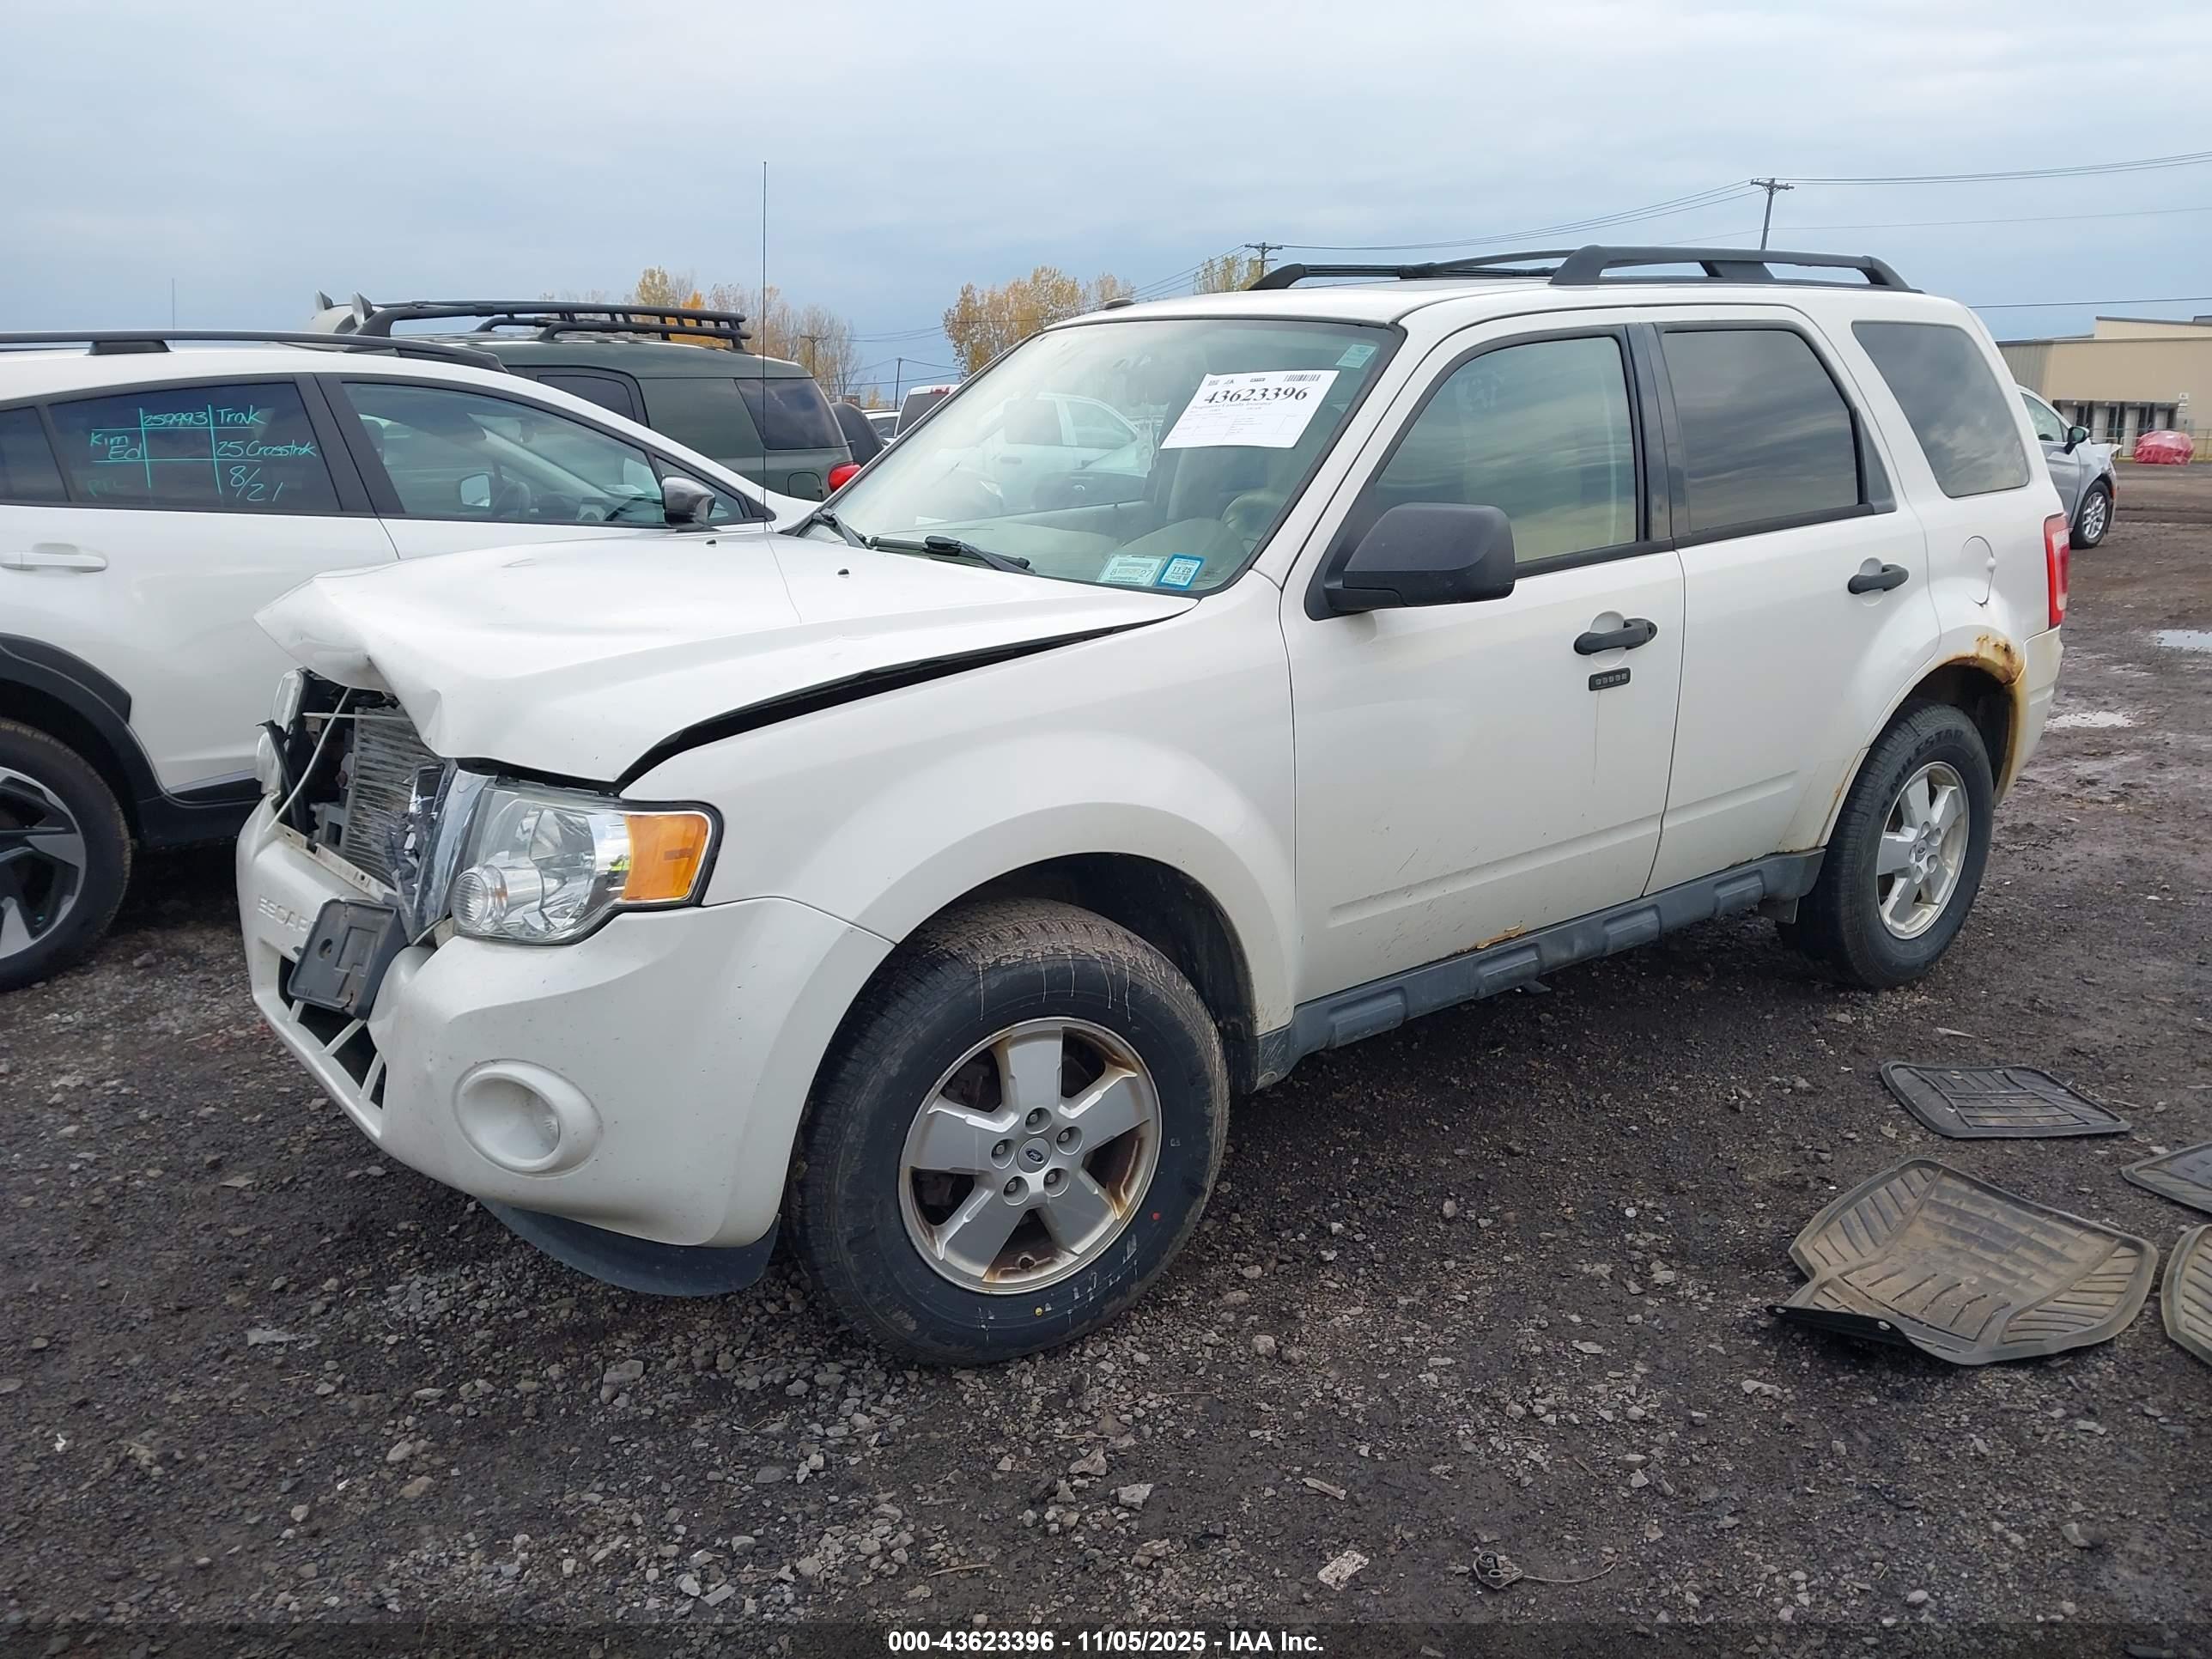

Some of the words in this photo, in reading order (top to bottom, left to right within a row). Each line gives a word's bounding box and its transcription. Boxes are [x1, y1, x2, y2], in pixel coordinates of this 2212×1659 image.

[1204, 386, 1311, 404] 43623396
[143, 411, 208, 426] 259993
[89, 432, 129, 447] Kim
[108, 443, 142, 460] Ed
[216, 441, 244, 457] 25
[258, 896, 313, 933] ESCAP
